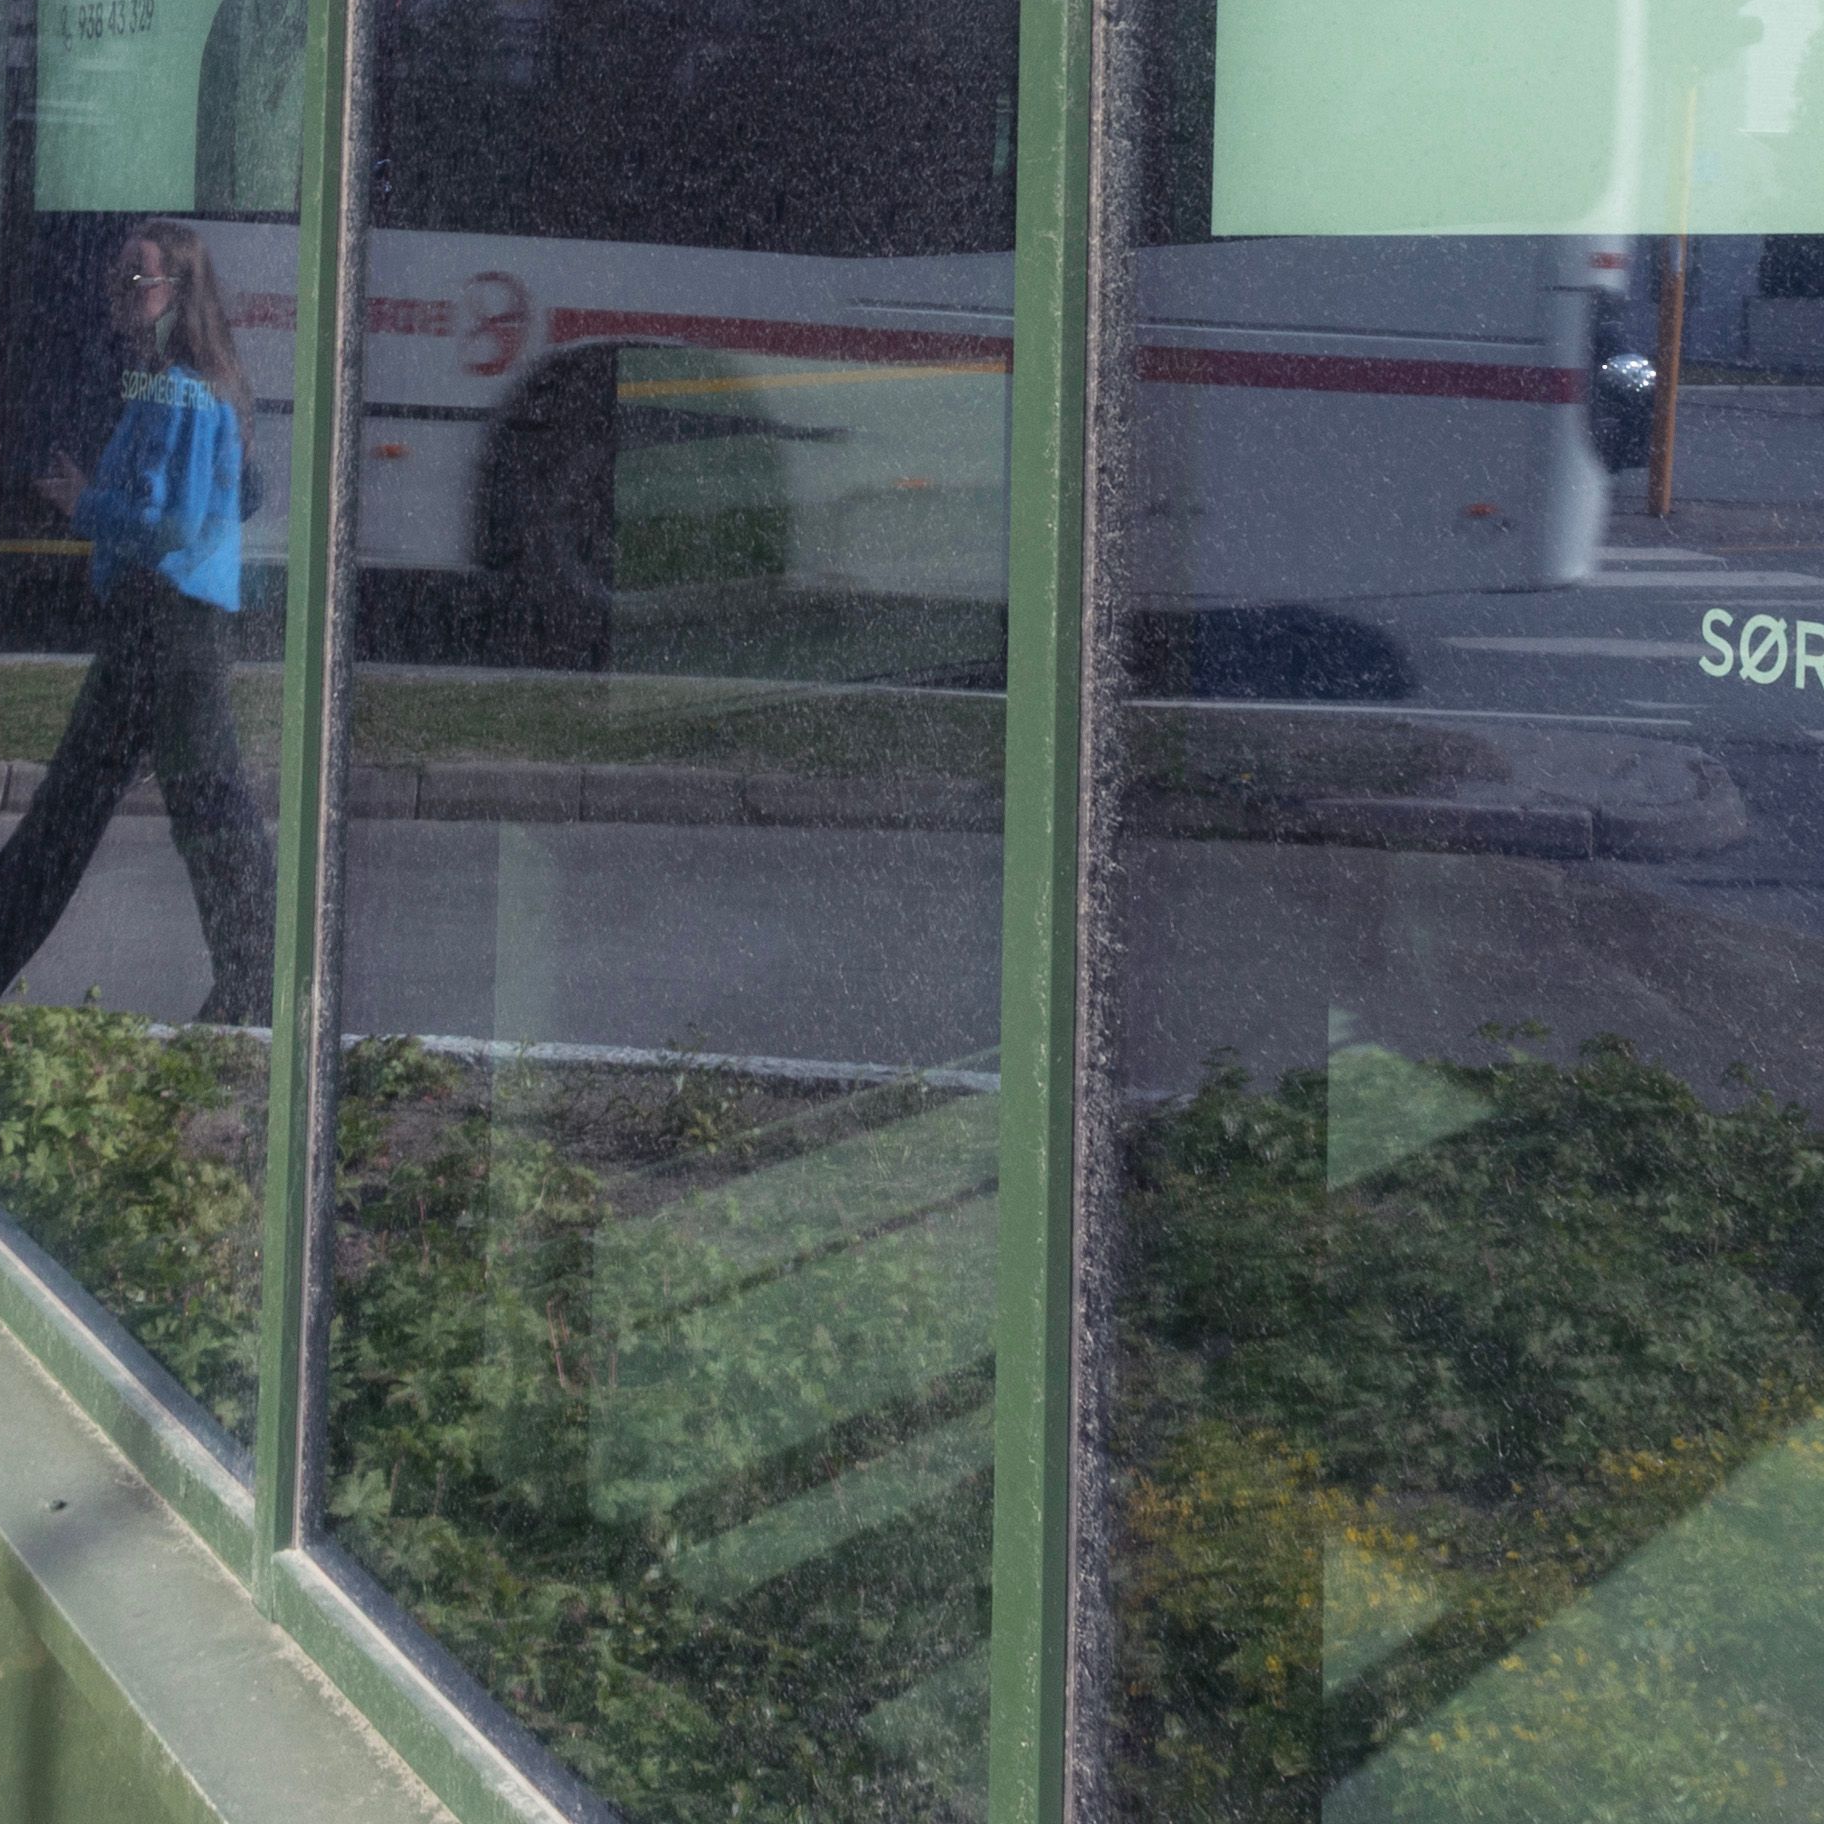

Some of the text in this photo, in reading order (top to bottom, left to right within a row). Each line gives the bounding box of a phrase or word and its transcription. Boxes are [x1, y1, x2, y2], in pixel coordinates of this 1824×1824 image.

[78, 2, 103, 40] 938
[108, 0, 125, 36] 43
[120, 368, 217, 413] SØRMEGLEREN
